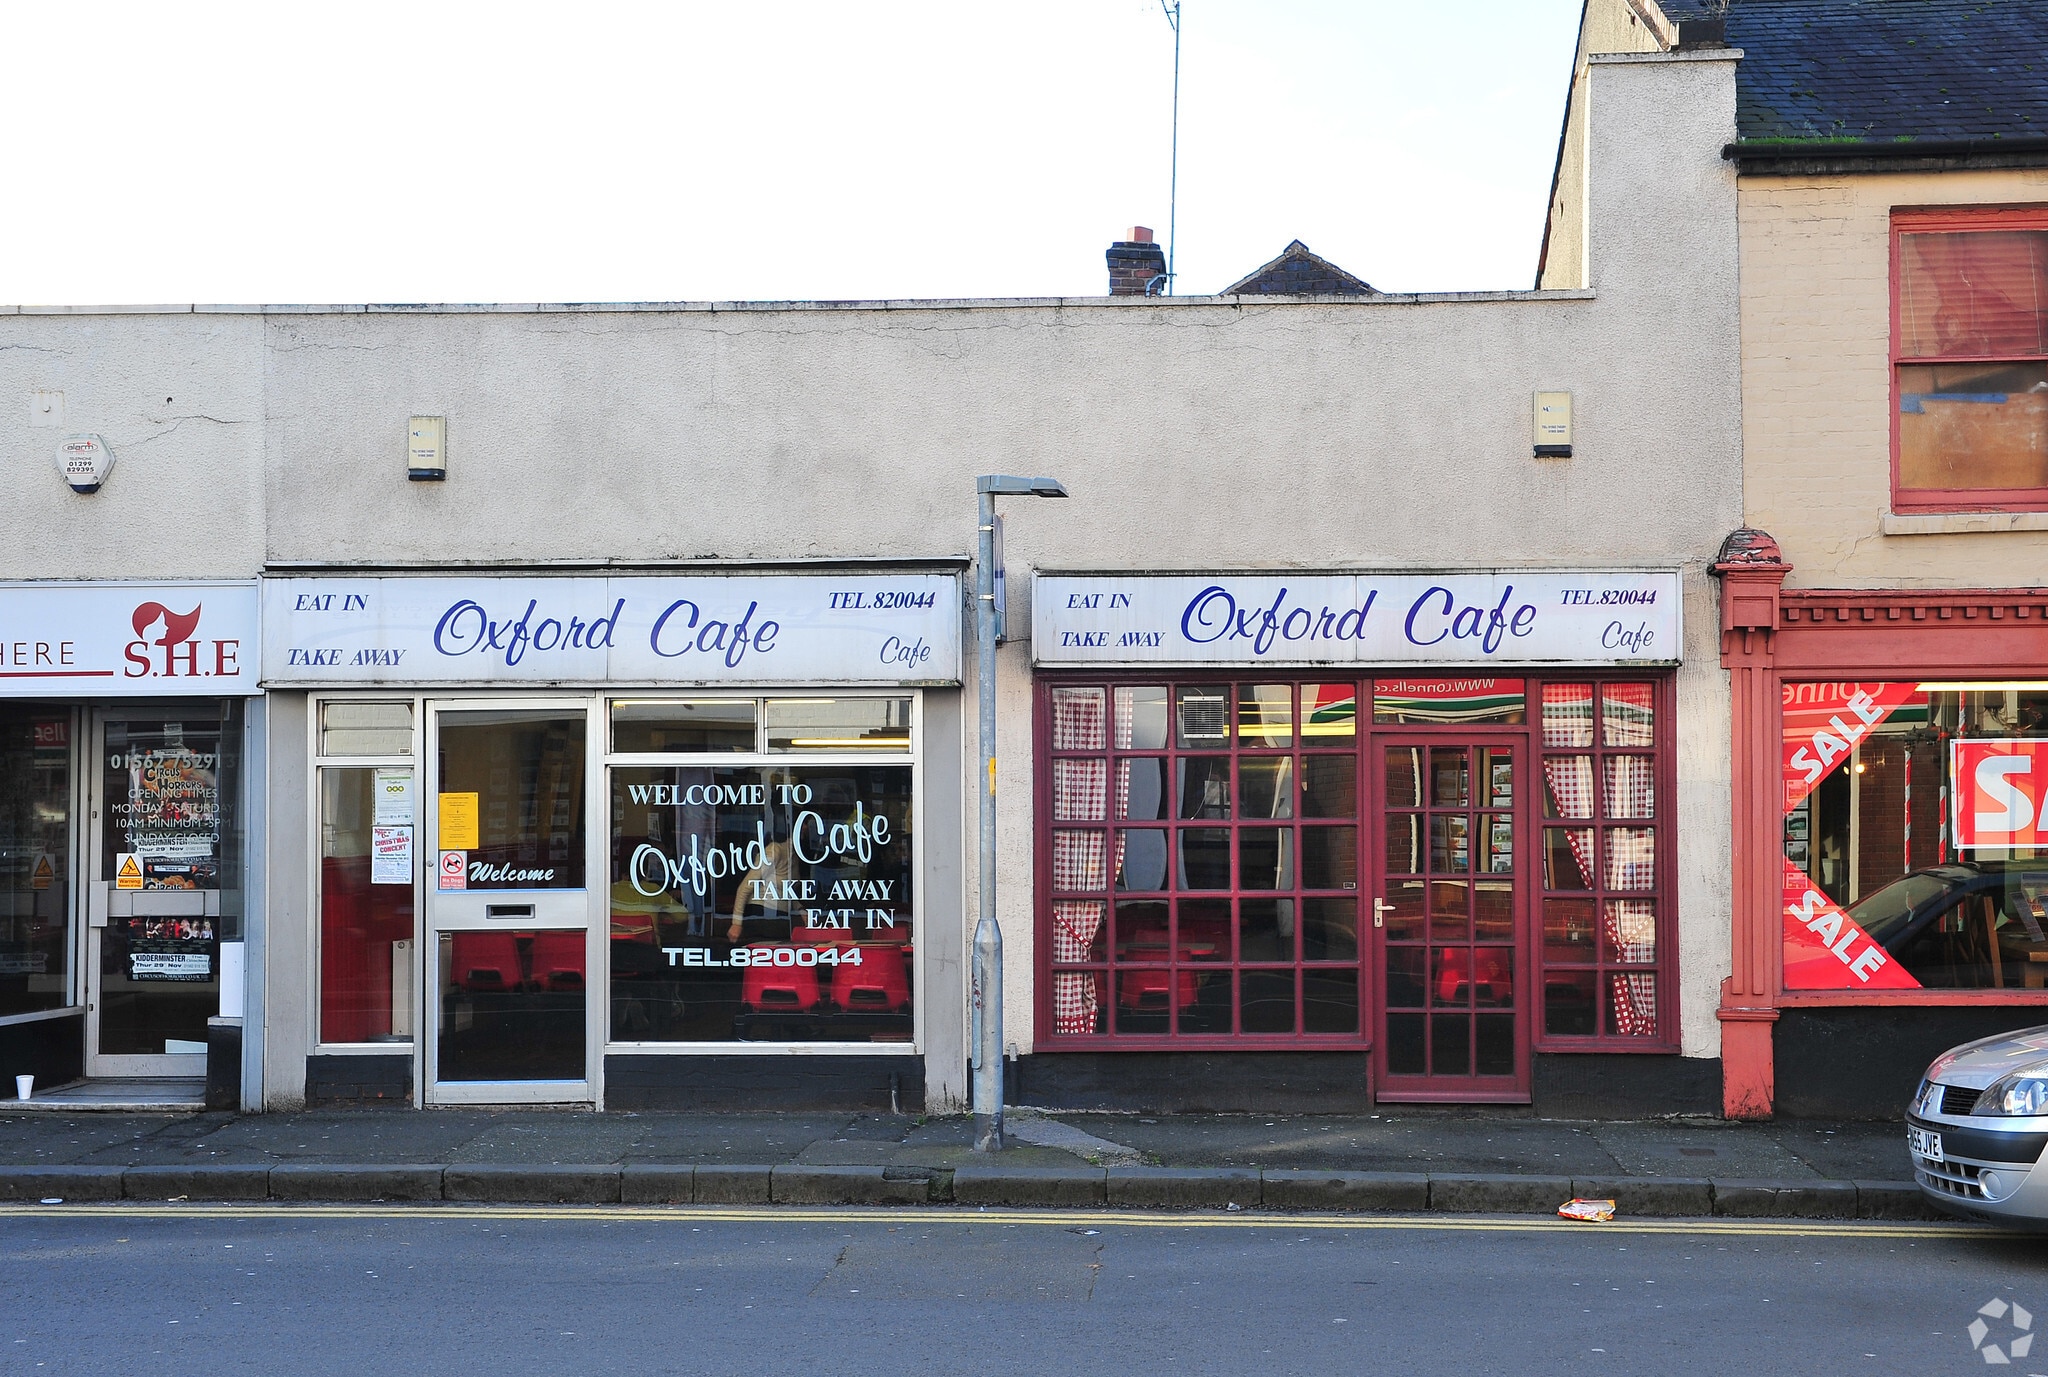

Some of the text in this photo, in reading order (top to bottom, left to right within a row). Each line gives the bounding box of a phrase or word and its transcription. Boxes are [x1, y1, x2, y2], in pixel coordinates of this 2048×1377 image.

[293, 594, 336, 611] EAT
[342, 594, 370, 611] IN
[828, 591, 936, 610] TEL.820044
[1066, 593, 1133, 609] EAT IN
[1559, 589, 1657, 606] TEL.820044
[1181, 585, 1537, 655] Oxford Cafe
[433, 598, 780, 668] Oxford Cafe
[1060, 631, 1166, 647] TAKE AWAY
[1601, 620, 1655, 654] Cafe
[123, 639, 241, 678] S.H.E
[287, 648, 407, 666] TAKE AWAY
[879, 635, 931, 669] Cafe
[1790, 689, 1885, 784] SALE
[110, 753, 165, 769] 01562
[128, 788, 218, 799] OPENING TIMES
[627, 783, 813, 806] WELCOME TO
[1974, 754, 2048, 833] S
[111, 803, 164, 814] MONDAY
[115, 818, 145, 828] 10AM
[147, 818, 202, 828] MINIMUM
[124, 832, 171, 843] SUNDAY
[174, 832, 220, 843] CLOSED
[629, 800, 892, 897] Oxford Cafe
[468, 861, 555, 882] Welcome
[747, 879, 895, 901] TAKE AWAY
[805, 908, 896, 930] EAT IN
[1788, 890, 1887, 983] SALE
[135, 954, 186, 962] KIDDERMINSTER
[661, 947, 863, 967] TEL.820044
